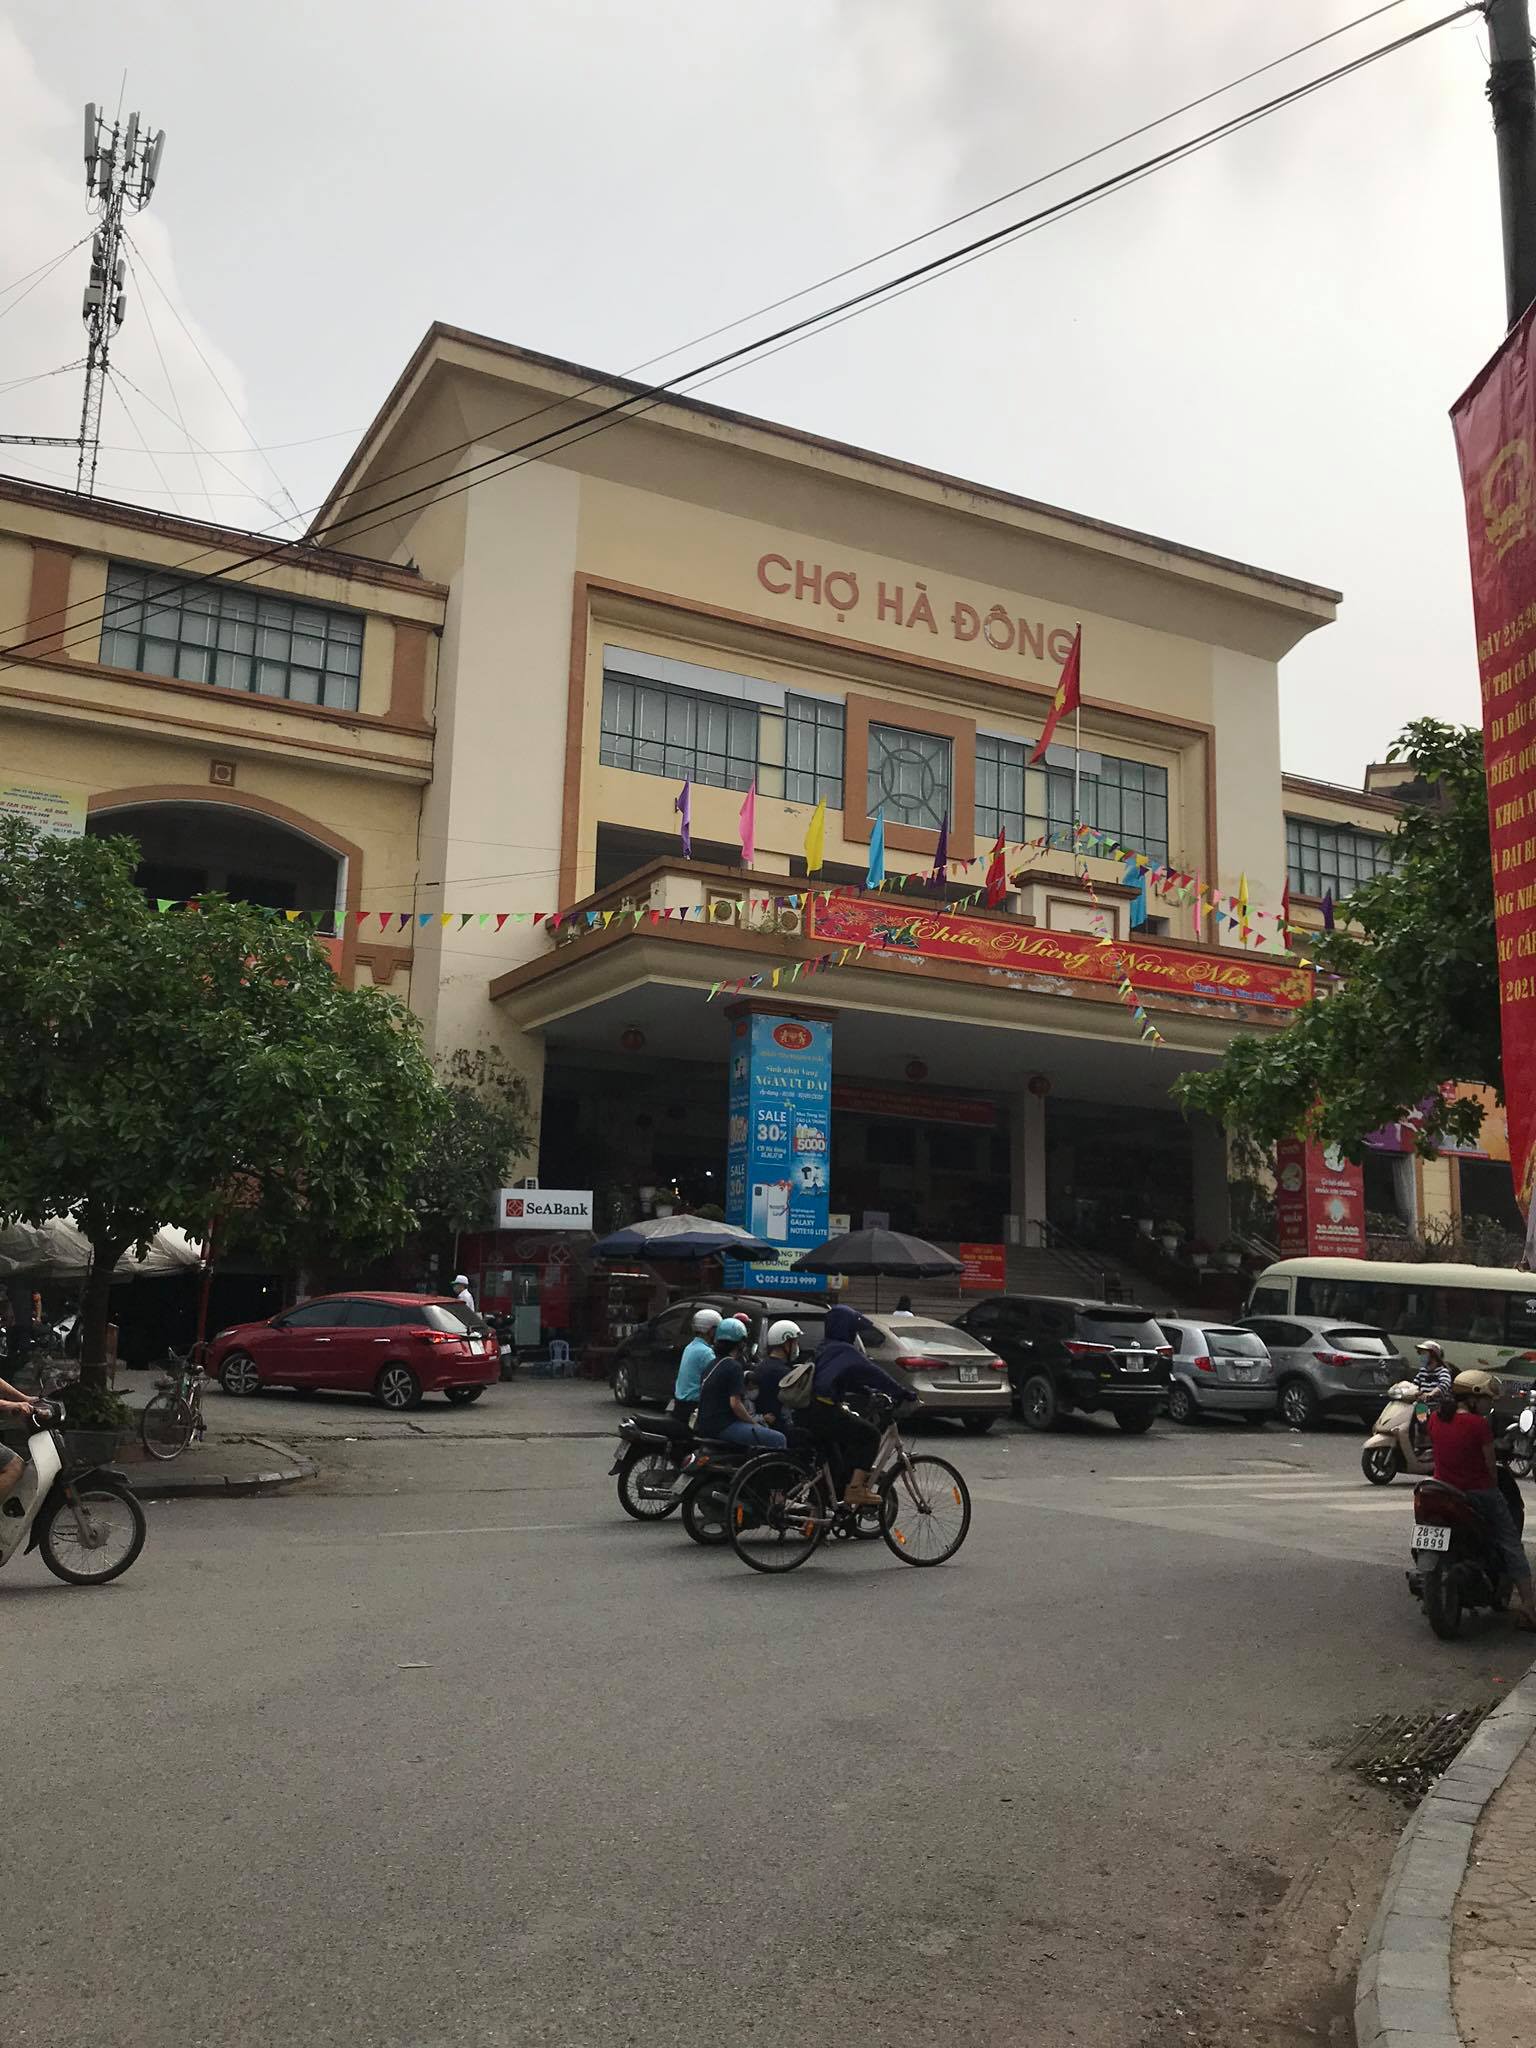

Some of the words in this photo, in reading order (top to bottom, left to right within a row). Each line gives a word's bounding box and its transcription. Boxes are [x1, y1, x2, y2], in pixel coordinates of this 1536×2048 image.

[757, 553, 860, 622] CHỢ
[877, 581, 938, 634] HÀ
[951, 603, 1078, 665] ĐÔNG
[991, 931, 1091, 970] Mừng
[1506, 975, 1535, 1002] 2021
[757, 1109, 787, 1122] SALE
[757, 1124, 788, 1141] 30%
[796, 1138, 826, 1151] 5000
[526, 1202, 589, 1216] SeABank
[790, 1219, 816, 1227] GALAXY
[764, 1275, 779, 1284] 024
[1416, 1538, 1444, 1549] 6899
